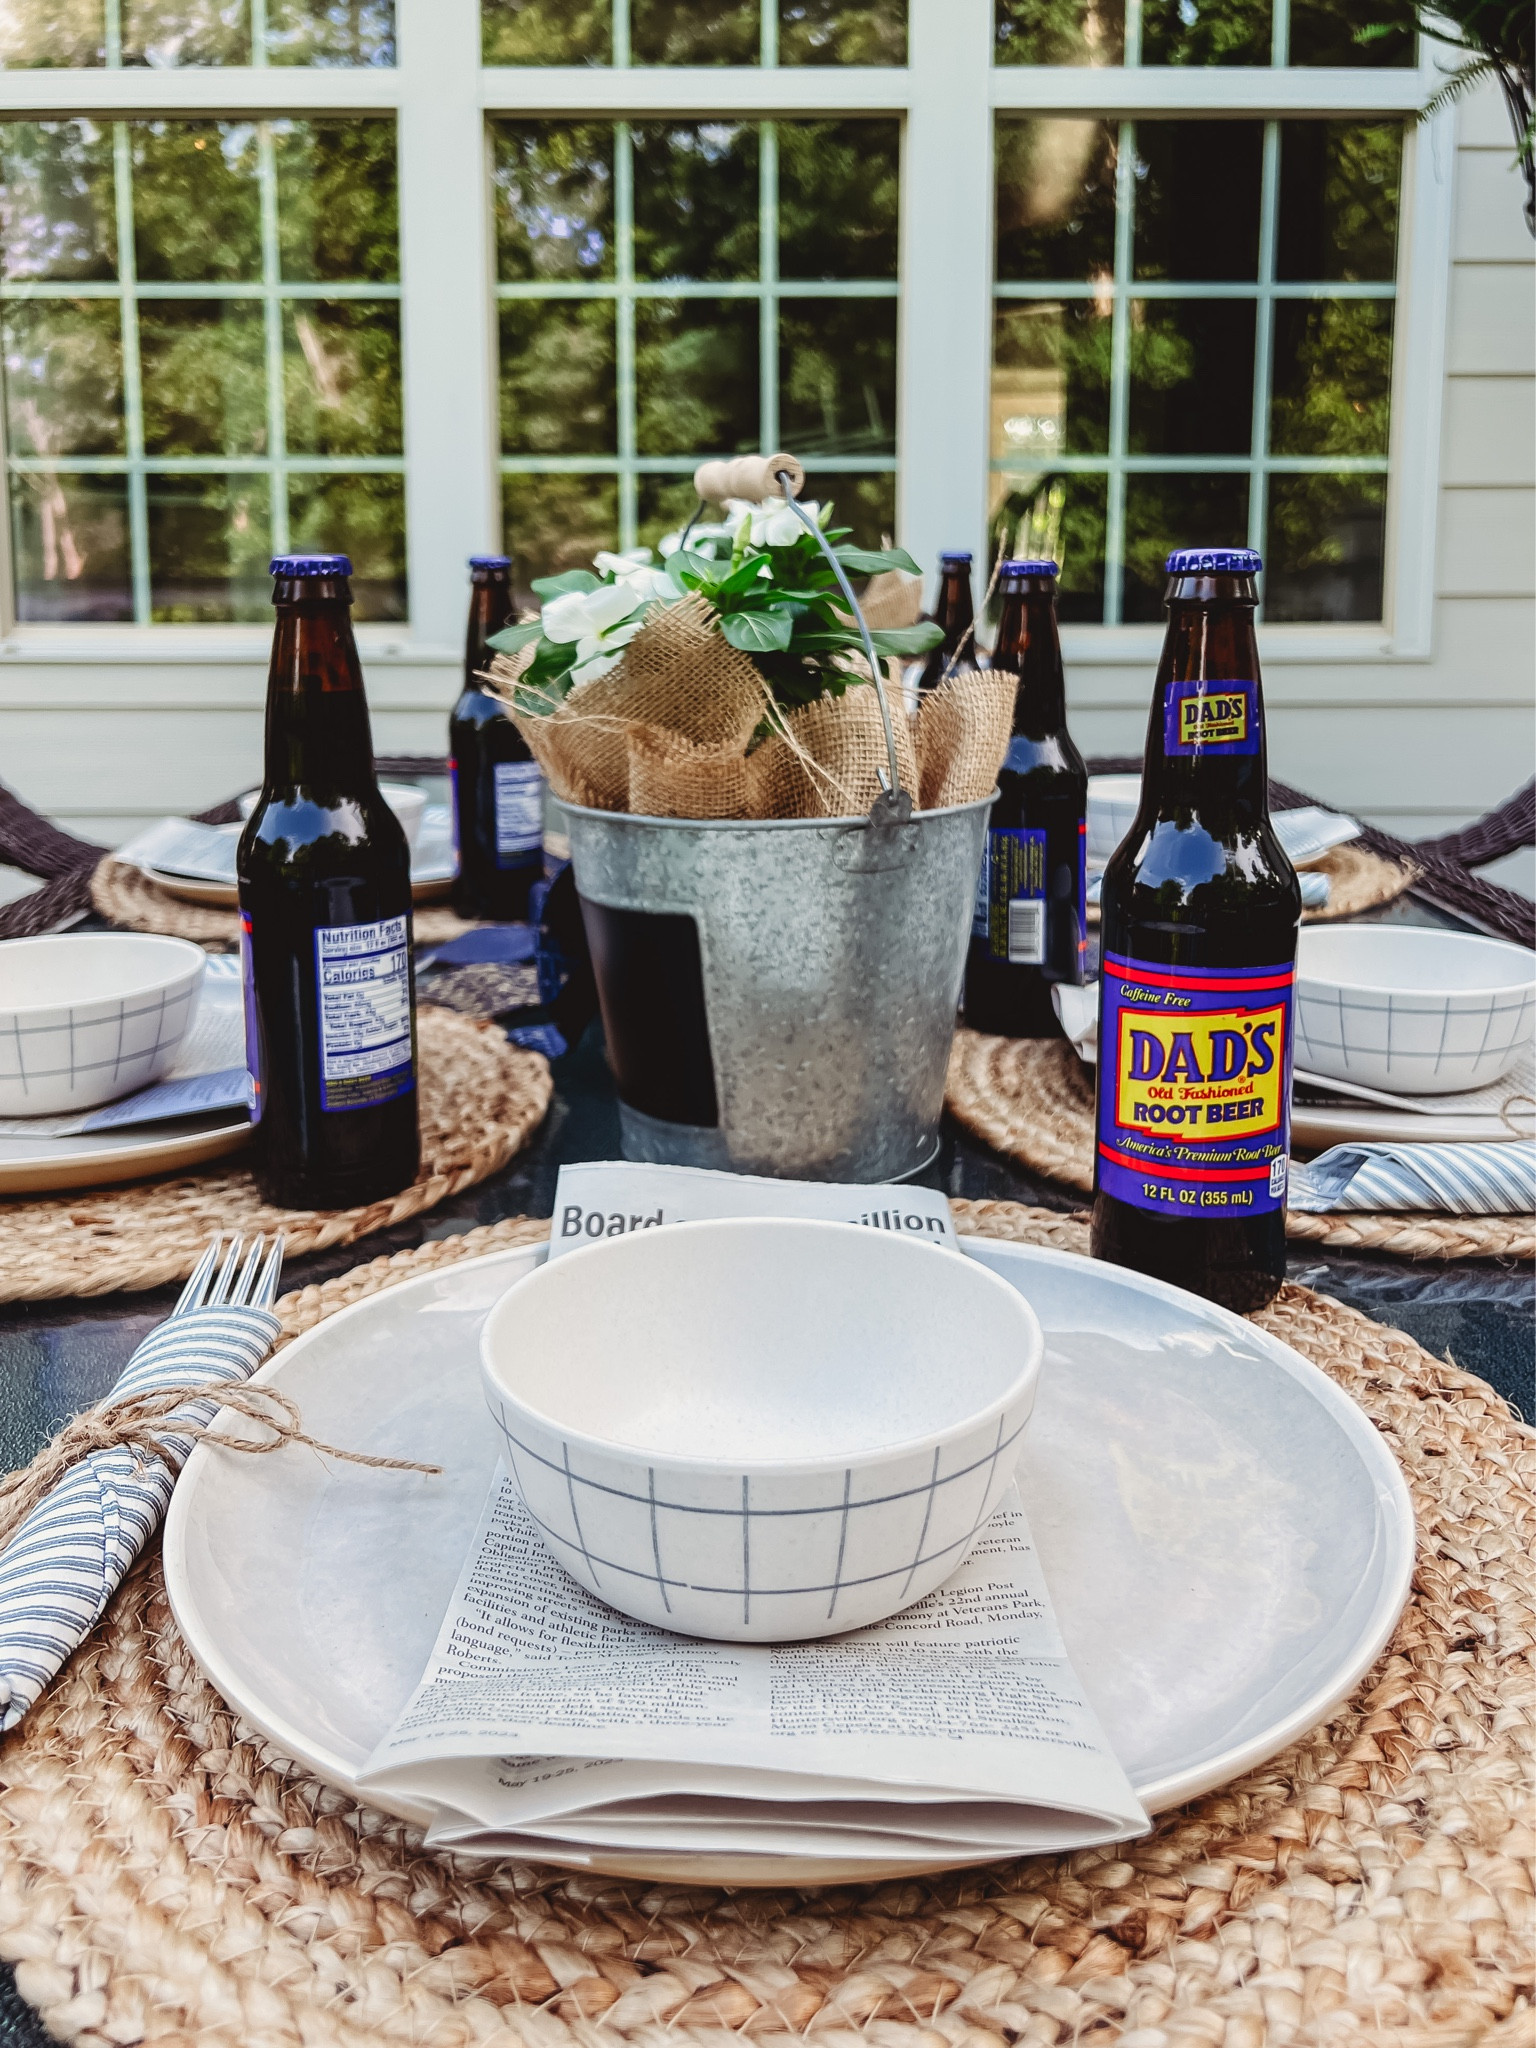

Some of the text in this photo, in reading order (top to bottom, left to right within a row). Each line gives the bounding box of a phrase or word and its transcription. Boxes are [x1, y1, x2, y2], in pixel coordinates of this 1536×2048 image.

[1185, 698, 1242, 725] DAD'S
[1188, 726, 1239, 740] ROOT BEER
[322, 921, 402, 944] Nutrition Facts
[323, 968, 375, 982] Calories
[392, 952, 406, 972] 170
[1120, 984, 1191, 1008] Caffeine Free
[1128, 1021, 1276, 1083] DAD'S
[1148, 1081, 1254, 1100] Old Fashioned
[1134, 1097, 1264, 1124] ROOT BEER
[1116, 1136, 1282, 1162] America's Premium Root Beer
[1272, 1157, 1286, 1177] 170
[1142, 1182, 1253, 1206] 12 FL OZ (355 mL)
[561, 1205, 664, 1237] Board
[848, 1210, 946, 1234] illion
[498, 1496, 514, 1504] for
[500, 1486, 512, 1494] to
[494, 1510, 530, 1522] transp
[496, 1502, 514, 1511] ask
[491, 1517, 522, 1528] parks
[503, 1525, 538, 1538] While
[988, 1520, 1015, 1530] oyle
[486, 1530, 530, 1546] portion
[977, 1536, 1022, 1546] veteran
[482, 1547, 546, 1563] Obligation
[484, 1538, 556, 1560] Capital Imp
[970, 1544, 1031, 1556] ment, has
[476, 1560, 526, 1572] projects
[530, 1568, 554, 1580] that
[543, 1565, 571, 1576] proj
[472, 1572, 566, 1600] reconstructing,
[474, 1565, 601, 1601] debt to cover, inclu
[940, 1586, 984, 1598] Legion
[988, 1582, 1014, 1591] Post
[470, 1578, 534, 1600] improving
[588, 1610, 611, 1620] and
[906, 1599, 944, 1610] ville's
[948, 1594, 981, 1606] 22nd
[985, 1590, 1030, 1602] annual
[938, 1610, 948, 1618] at
[952, 1604, 1009, 1616] Veterans
[1012, 1598, 1046, 1610] Park,
[464, 1592, 518, 1616] facilities
[521, 1611, 546, 1626] and
[548, 1622, 597, 1641] athletic
[467, 1586, 530, 1608] expansion
[534, 1604, 548, 1614] of
[550, 1610, 599, 1632] existing
[602, 1626, 636, 1636] parks
[946, 1616, 984, 1628] Road,
[988, 1611, 1044, 1624] Monday,
[456, 1616, 495, 1636] (bond
[498, 1630, 558, 1654] requests)
[494, 1616, 535, 1636] allows
[538, 1630, 558, 1642] for
[561, 1636, 622, 1650] flexibility
[914, 1640, 961, 1648] feature
[965, 1635, 1021, 1649] patriotic
[446, 1644, 502, 1664] Roberts.
[998, 1648, 1019, 1656] the
[438, 1666, 502, 1679] proposed
[458, 1660, 560, 1672] Commissioner
[498, 1778, 528, 1788] May
